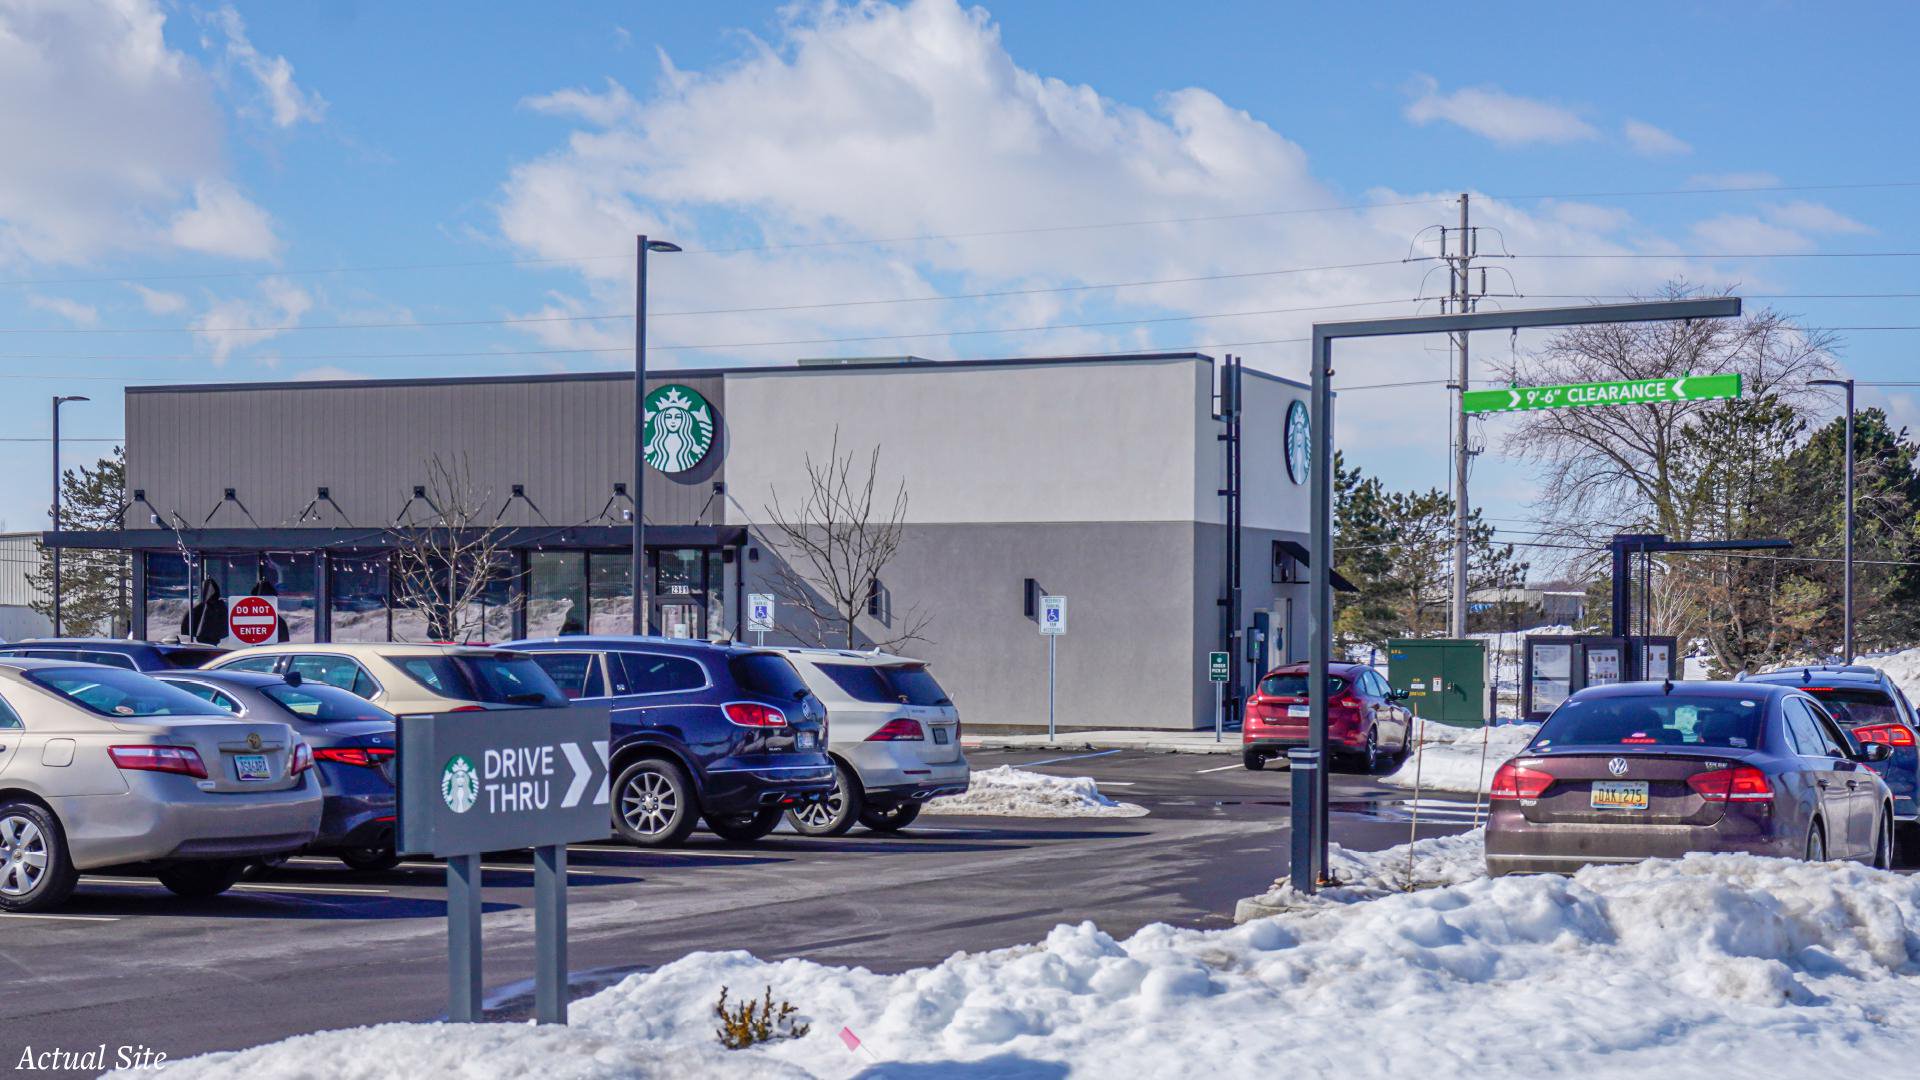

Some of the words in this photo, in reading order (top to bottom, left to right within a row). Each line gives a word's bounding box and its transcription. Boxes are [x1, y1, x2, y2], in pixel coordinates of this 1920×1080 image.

[1567, 382, 1667, 403] CLEARANCE
[236, 605, 249, 614] DO
[252, 605, 271, 614] NOT
[240, 627, 267, 635] ENTER
[484, 746, 554, 779] DRIVE
[485, 780, 549, 814] THRU
[1623, 788, 1642, 803] 275
